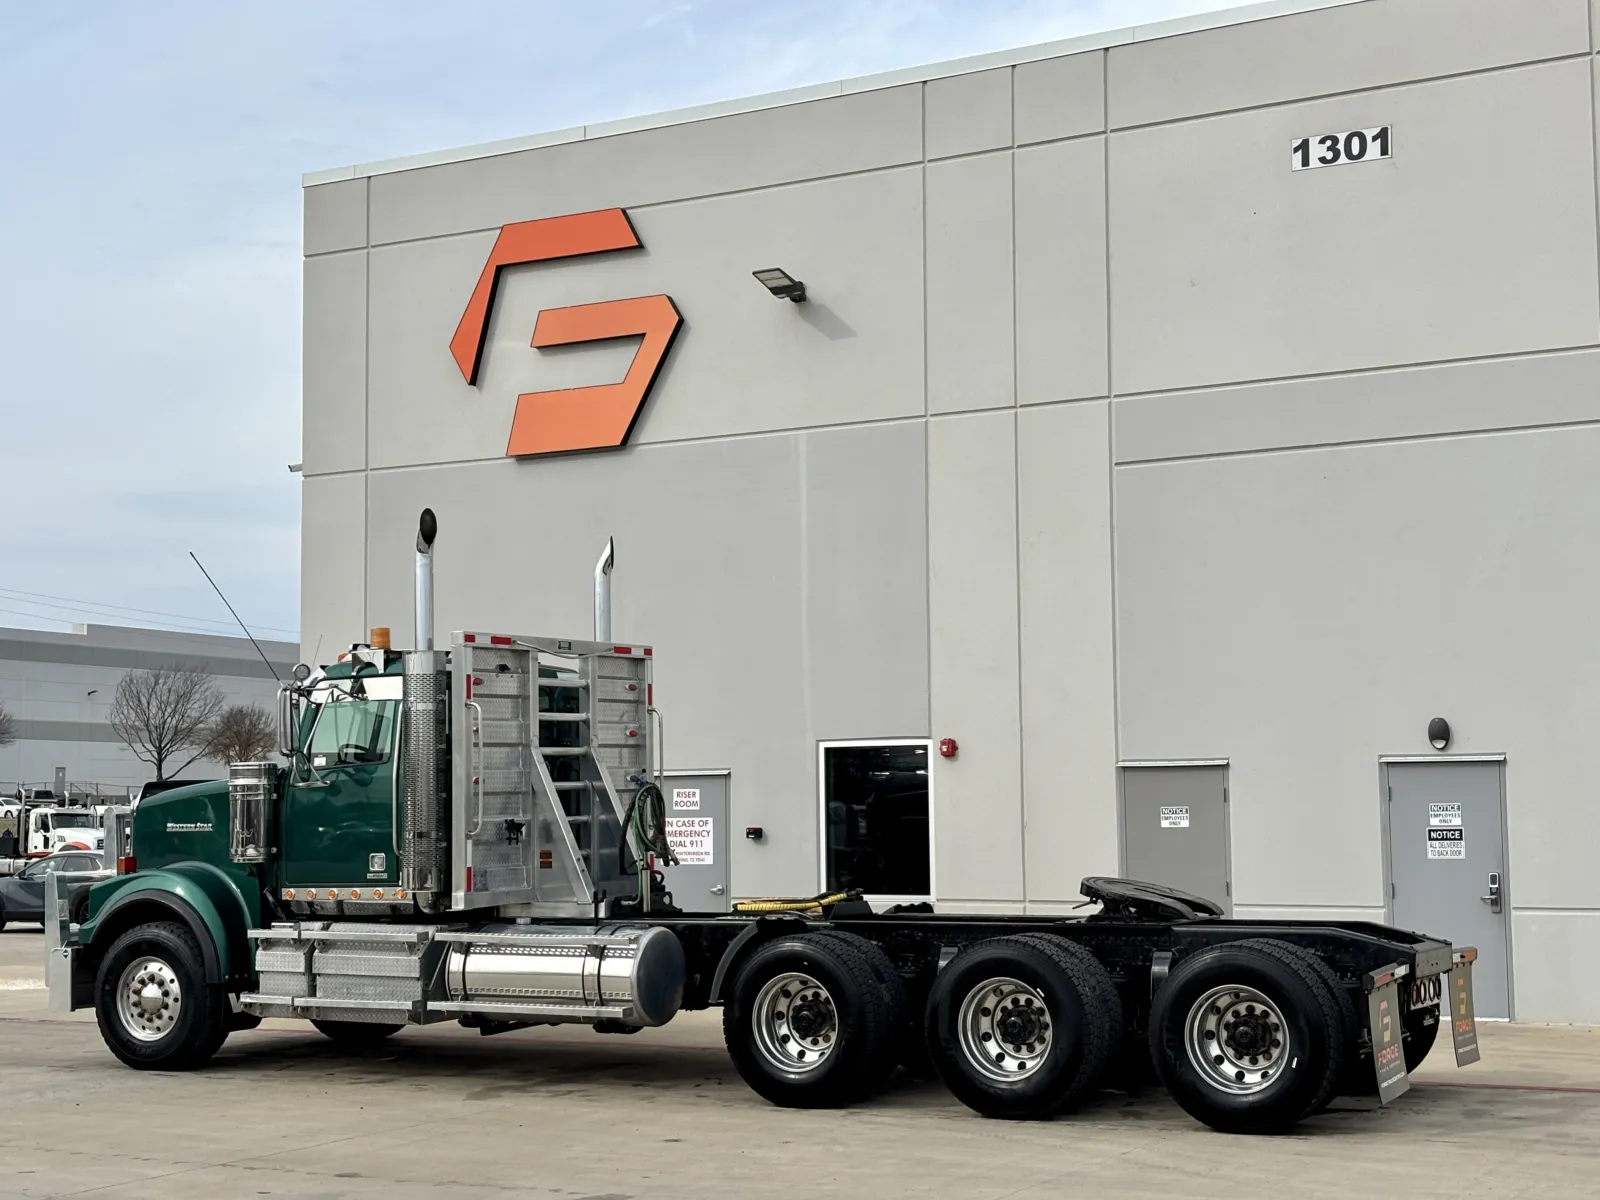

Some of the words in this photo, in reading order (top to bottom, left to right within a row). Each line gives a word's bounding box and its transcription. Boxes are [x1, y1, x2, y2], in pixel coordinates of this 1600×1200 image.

[1293, 126, 1389, 168] 1301
[676, 791, 697, 799] RISER
[674, 800, 699, 808] ROOM
[1431, 804, 1459, 812] NOTICE
[675, 820, 696, 828] CASE
[698, 820, 709, 828] OF
[1430, 831, 1461, 839] NOTICE
[670, 840, 688, 848] DIAL
[689, 840, 703, 848] 911
[1430, 849, 1437, 857] TO
[1450, 849, 1463, 857] DOOR
[1456, 1018, 1473, 1033] FORGE
[1377, 1043, 1399, 1066] FORGE
